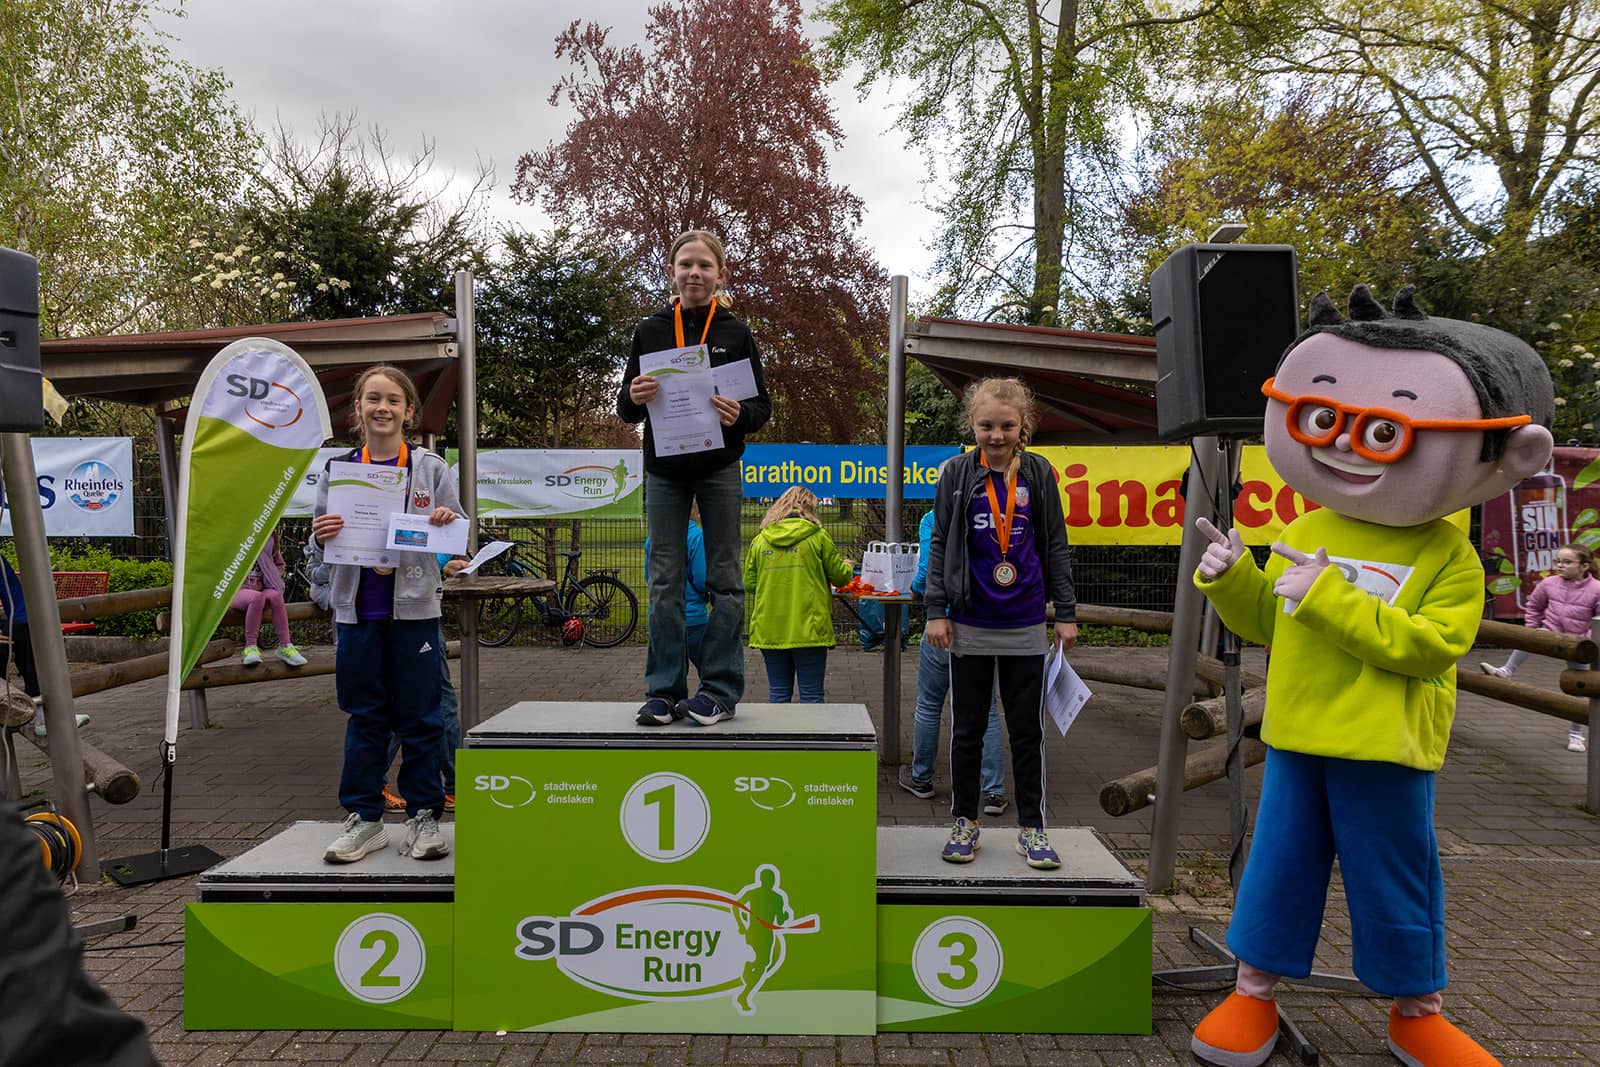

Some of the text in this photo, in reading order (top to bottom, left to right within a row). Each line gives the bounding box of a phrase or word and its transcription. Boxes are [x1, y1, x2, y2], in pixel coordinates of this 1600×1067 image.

[226, 374, 270, 400] SD
[306, 473, 321, 486] S
[739, 460, 939, 486] arathon Dinsake
[64, 478, 124, 491] Rheinfels
[498, 477, 533, 486] Dinslaken
[544, 475, 608, 487] SD Energy
[583, 487, 602, 495] Run
[1521, 506, 1559, 532] SIN
[213, 465, 296, 600] stadtwerke-dinslaken.de
[1525, 530, 1560, 551] CON
[406, 566, 424, 578] 29
[474, 775, 510, 790] SD
[543, 781, 598, 791] stadtwerke
[734, 776, 770, 792] SD
[803, 783, 858, 793] stadtwerke
[547, 794, 594, 804] dinslaken
[807, 796, 854, 806] dinslaken
[643, 783, 676, 850] 1
[519, 920, 721, 957] SD Energy
[359, 929, 400, 987] 2
[936, 931, 979, 990] 3
[643, 956, 702, 983] Run
